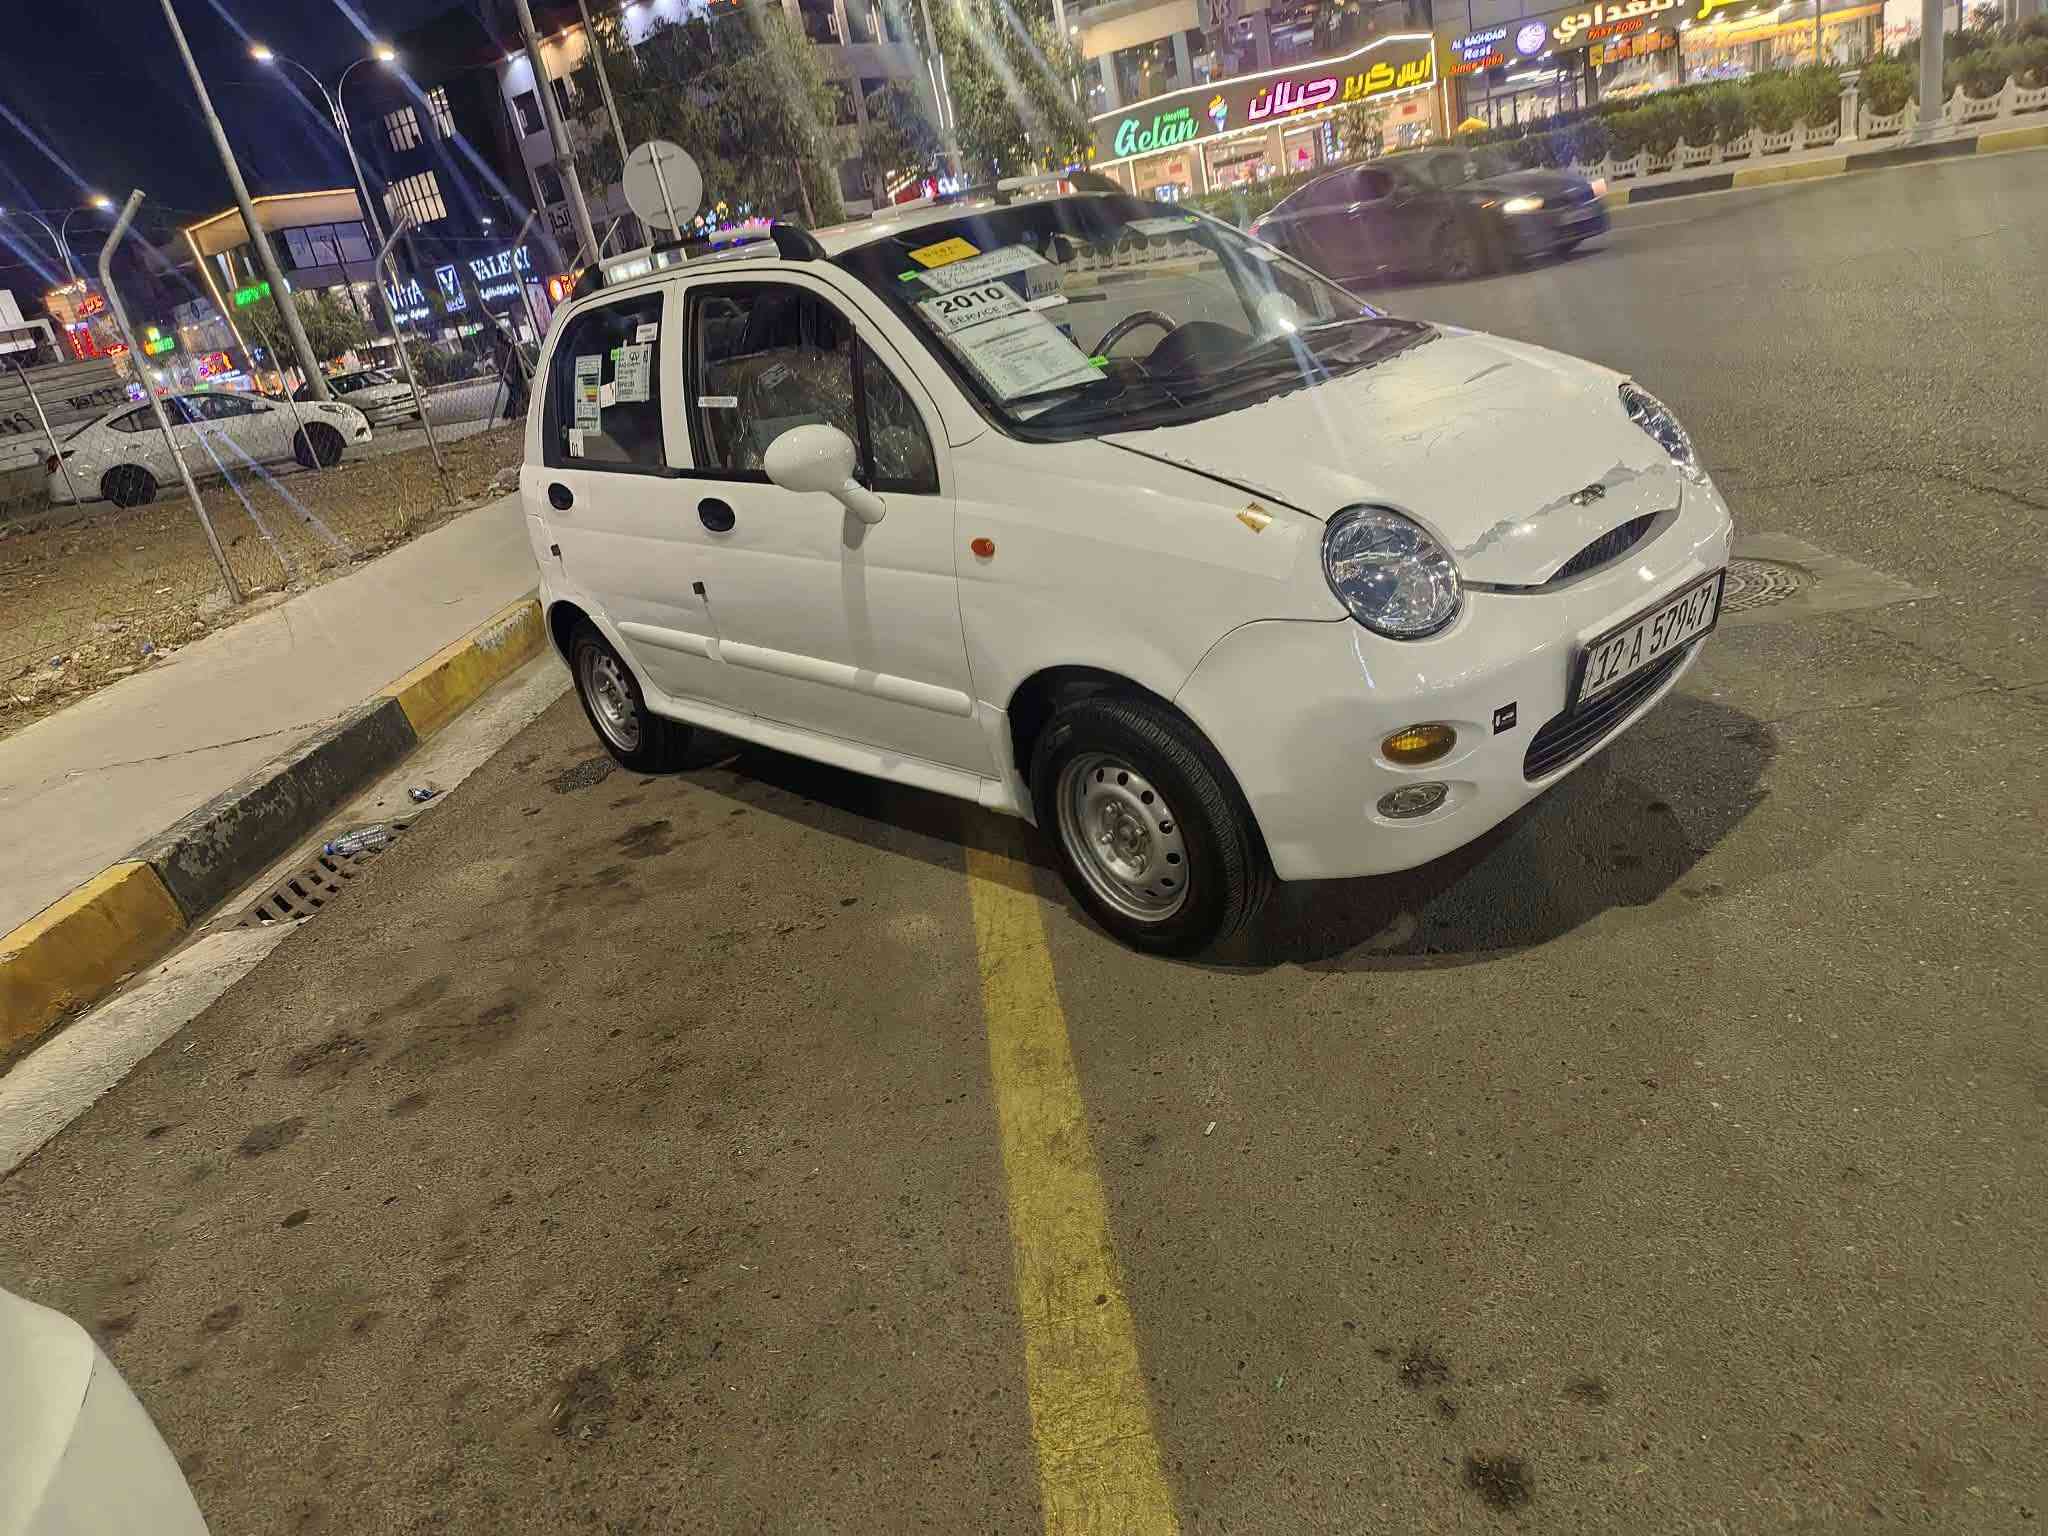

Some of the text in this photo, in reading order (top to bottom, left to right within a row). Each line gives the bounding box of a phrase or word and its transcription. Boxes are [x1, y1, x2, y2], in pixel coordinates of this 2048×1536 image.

[1247, 75, 1338, 121] جيلان
[1114, 116, 1200, 157] Gelan
[935, 286, 1005, 316] 2010
[1592, 583, 1713, 688] 12 A 57947
